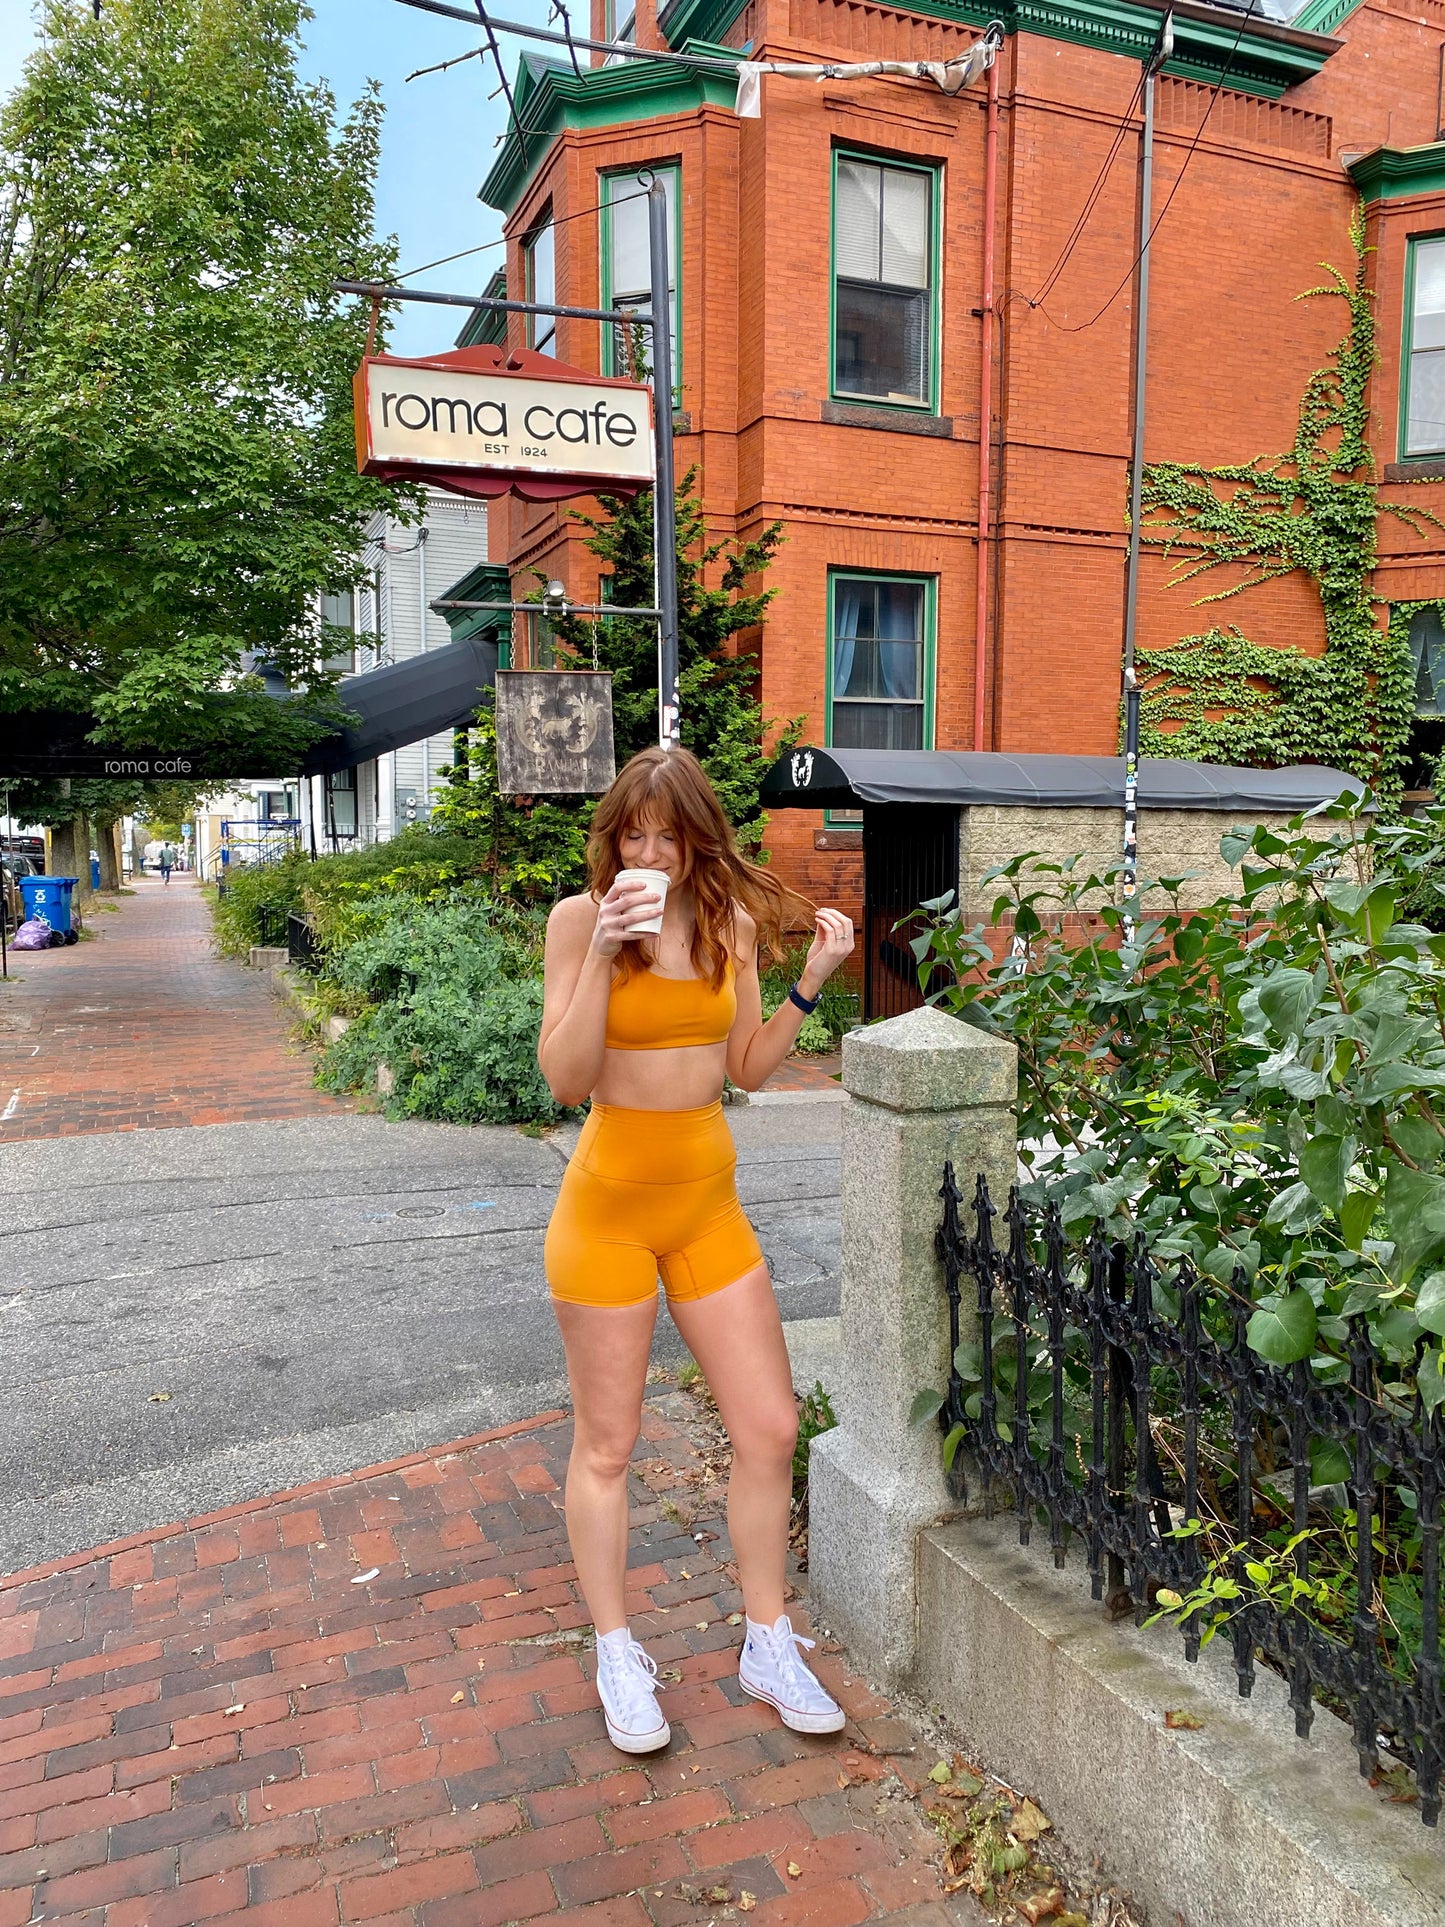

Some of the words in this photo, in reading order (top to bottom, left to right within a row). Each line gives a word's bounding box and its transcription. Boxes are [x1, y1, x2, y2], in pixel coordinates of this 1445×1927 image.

[381, 391, 508, 438] roma
[524, 400, 637, 447] cafe
[484, 443, 510, 455] EST
[521, 445, 548, 457] 1924
[105, 760, 149, 774] roma
[154, 756, 192, 774] cafe
